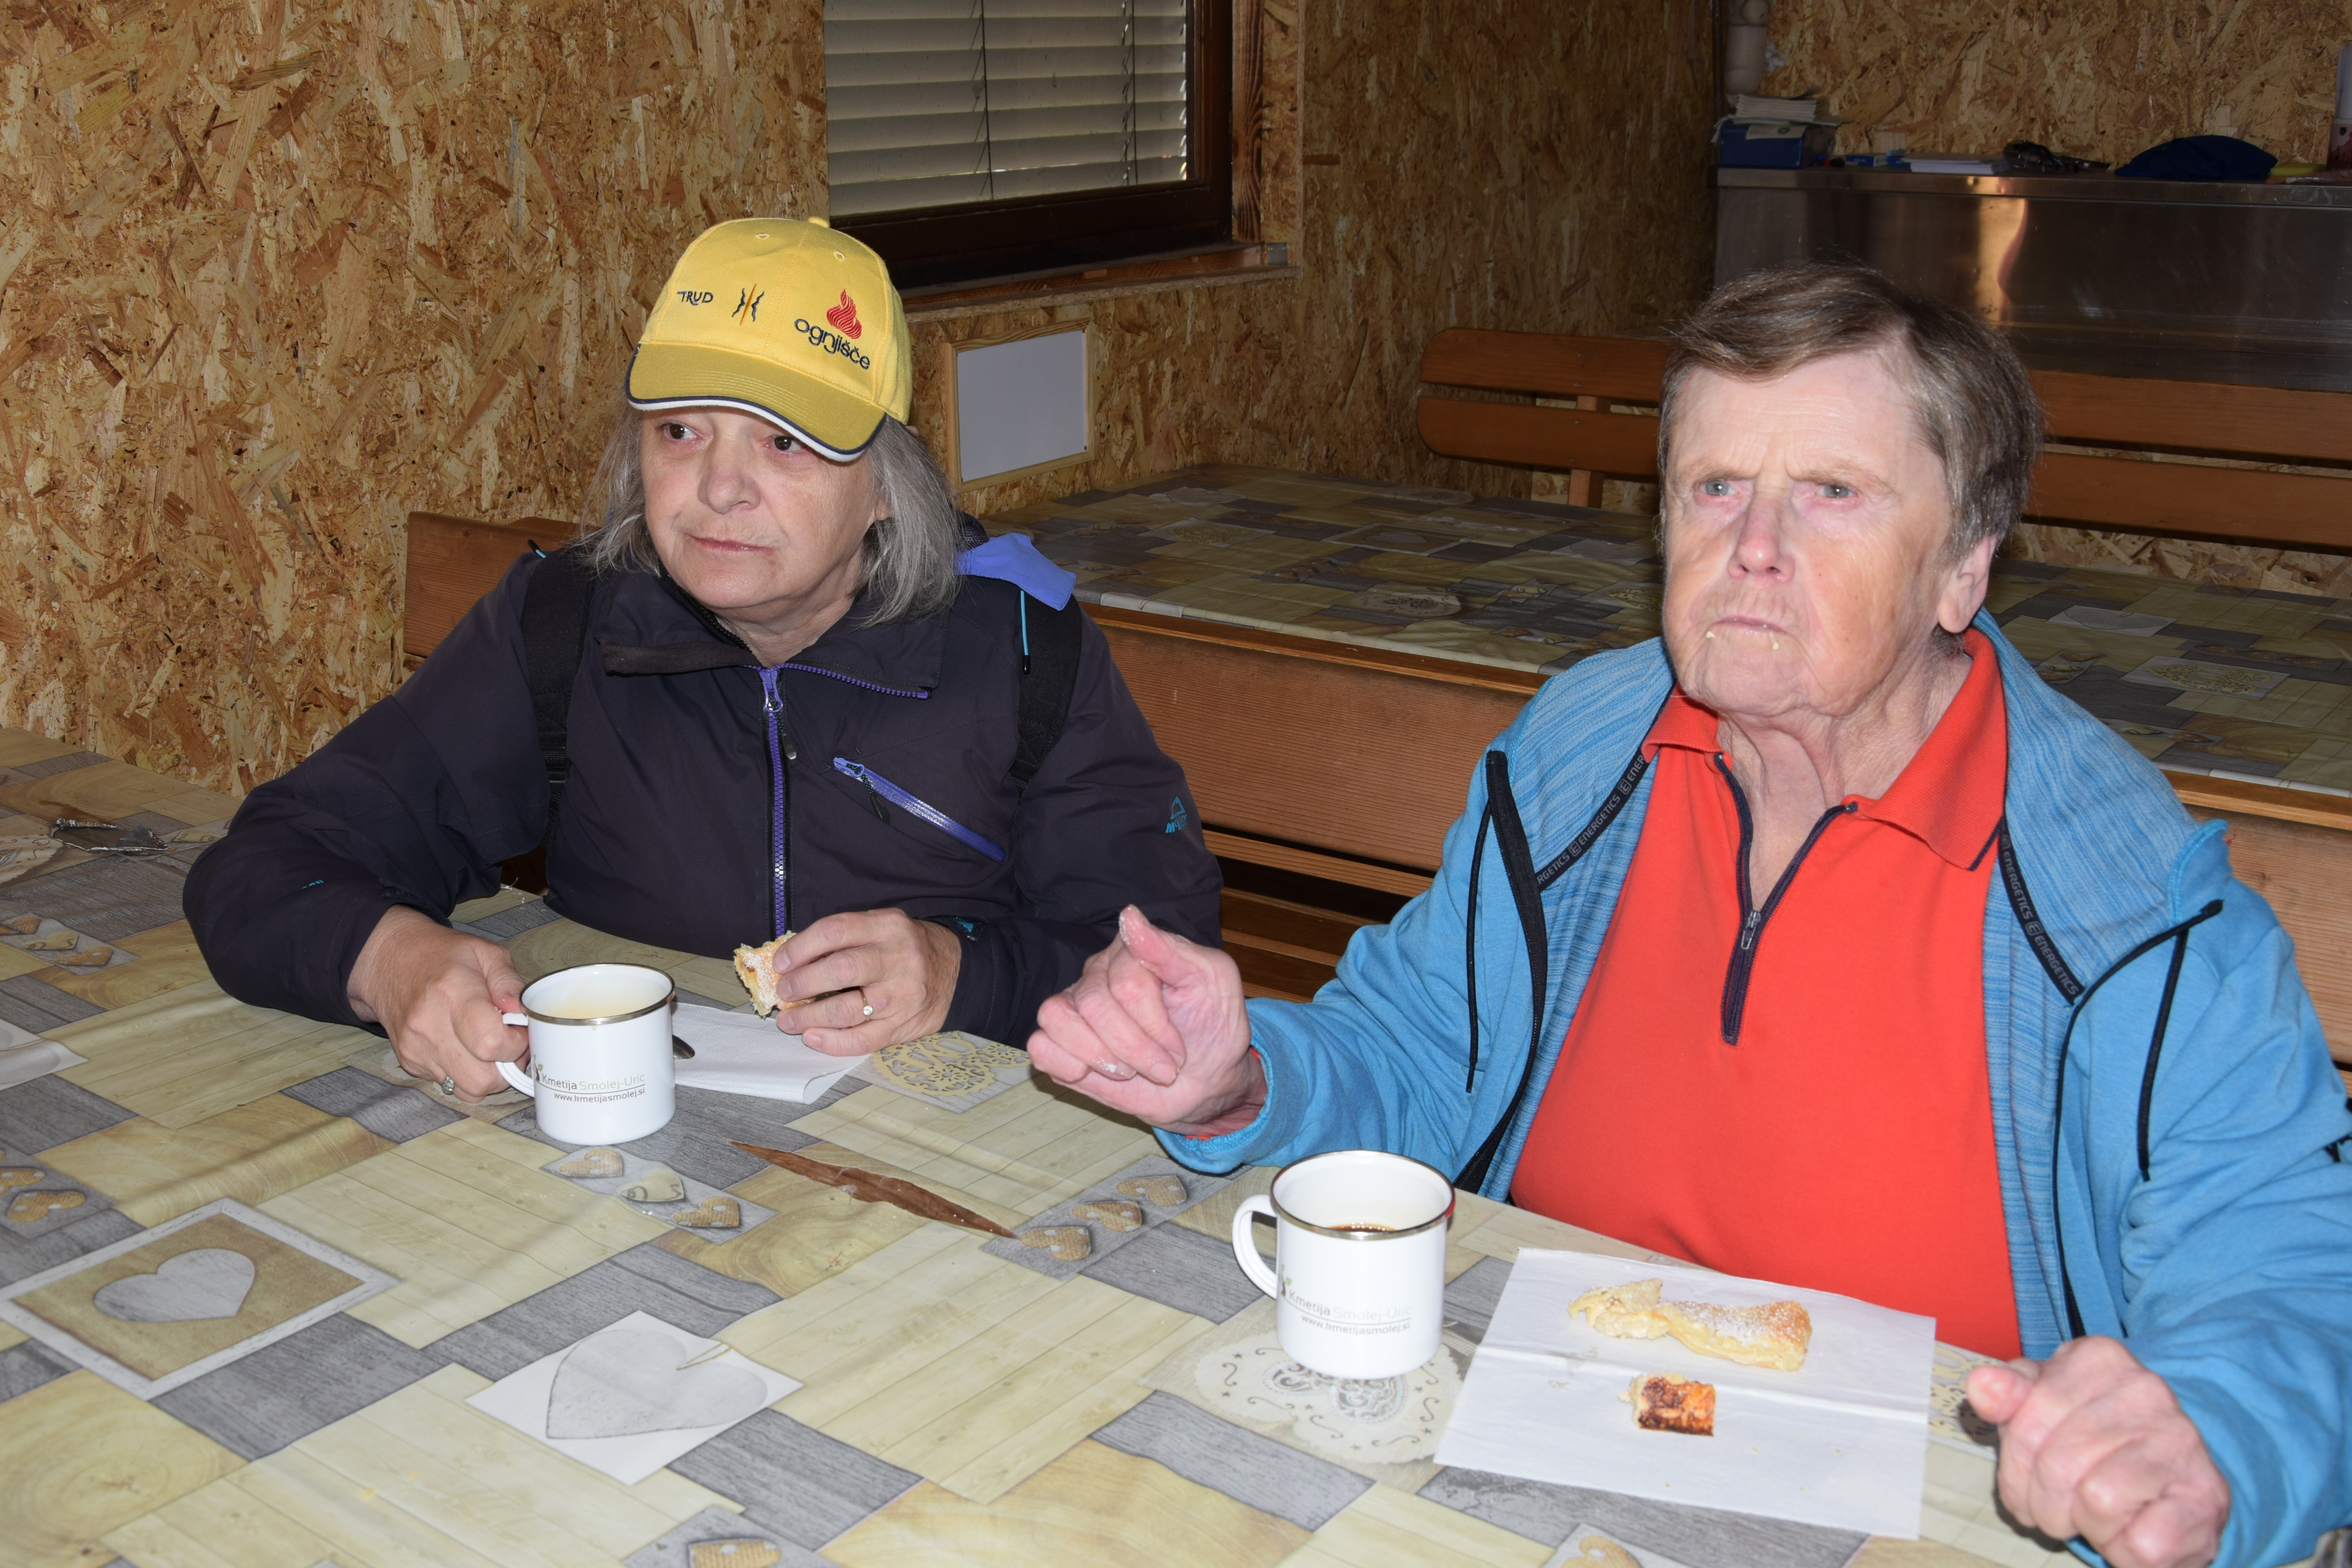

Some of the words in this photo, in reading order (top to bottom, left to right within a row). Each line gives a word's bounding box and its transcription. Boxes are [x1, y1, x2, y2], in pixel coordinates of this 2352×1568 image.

[677, 291, 714, 306] TRUD
[794, 318, 870, 369] ognjišče
[1579, 794, 1620, 845] ENERGETICS
[2003, 851, 2033, 920] ENERGETICS
[2034, 935, 2079, 995] ENERGETICS
[542, 1073, 577, 1091] Kmetija
[579, 1074, 645, 1090] Smolej-Uric
[554, 1087, 645, 1103] www.kmetijasmolej.si
[1289, 1289, 1330, 1316] Kmetija
[1333, 1306, 1412, 1322] Smolej-Uric
[1301, 1314, 1410, 1336] www.kmetijasmolej.si
